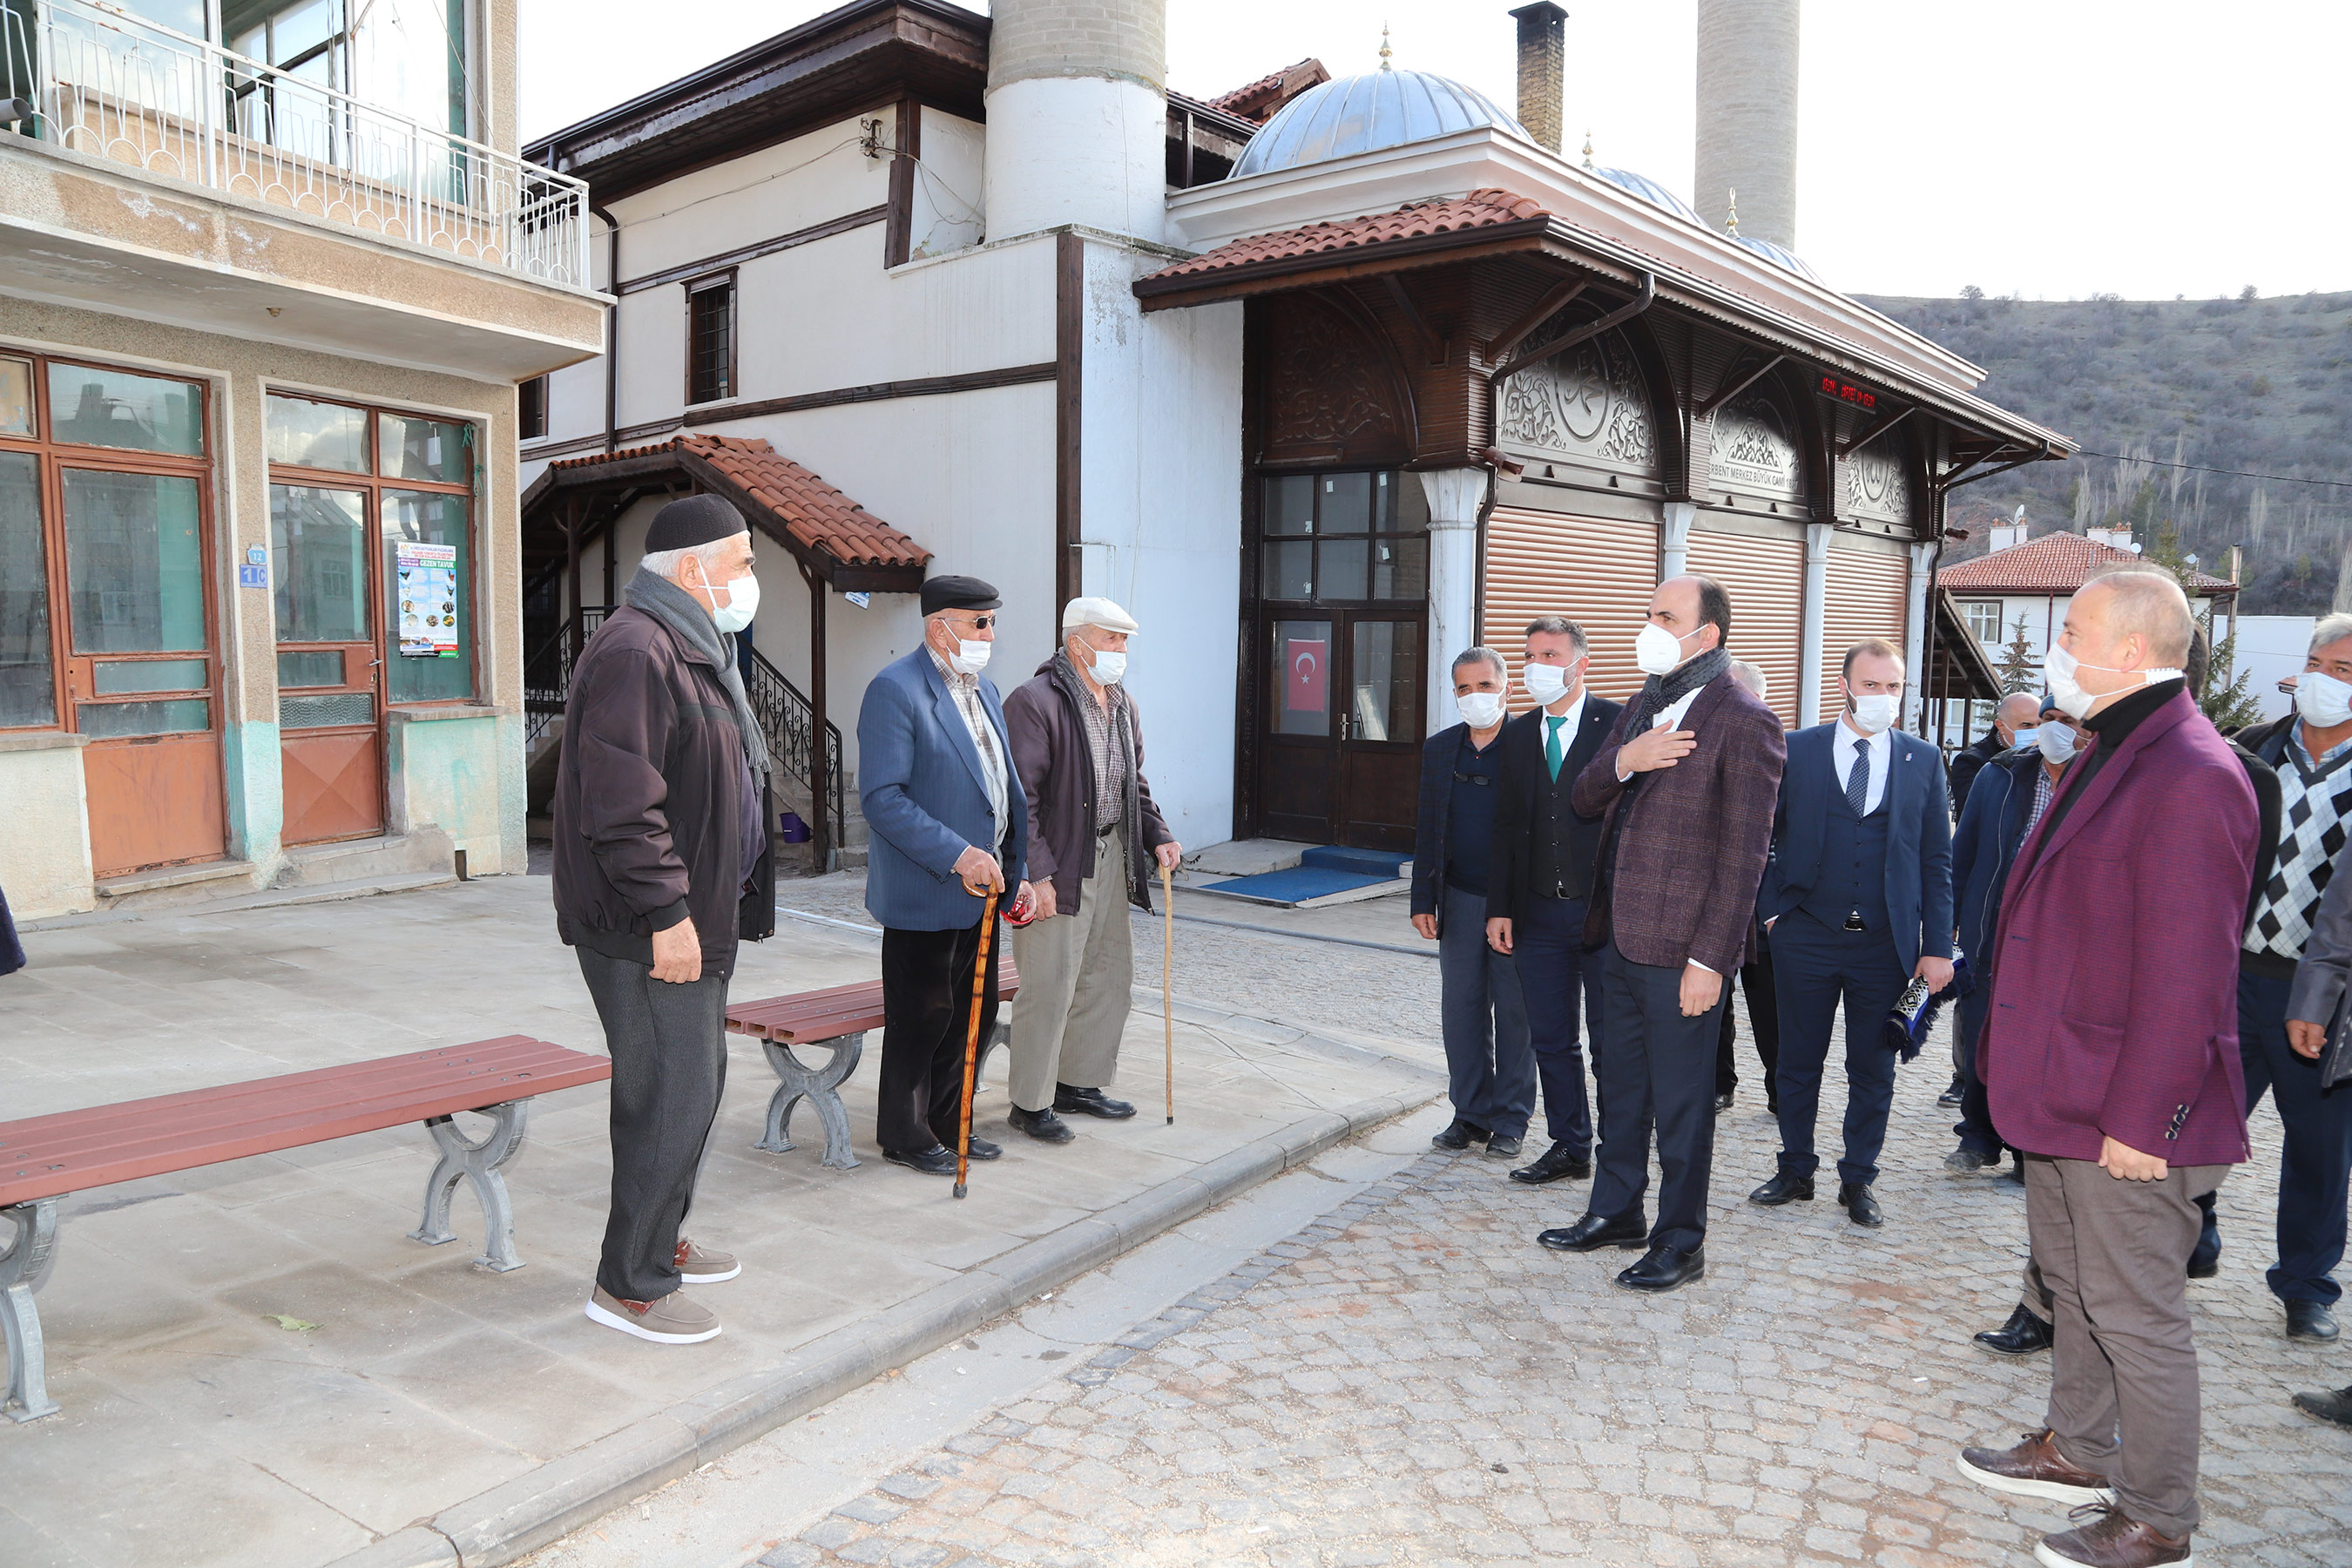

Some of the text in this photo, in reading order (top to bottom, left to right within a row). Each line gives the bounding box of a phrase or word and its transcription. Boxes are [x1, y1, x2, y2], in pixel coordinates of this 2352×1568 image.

[1730, 467, 1753, 481] MERKEZ
[1754, 470, 1771, 485] BÜYÜK
[253, 552, 262, 561] 12
